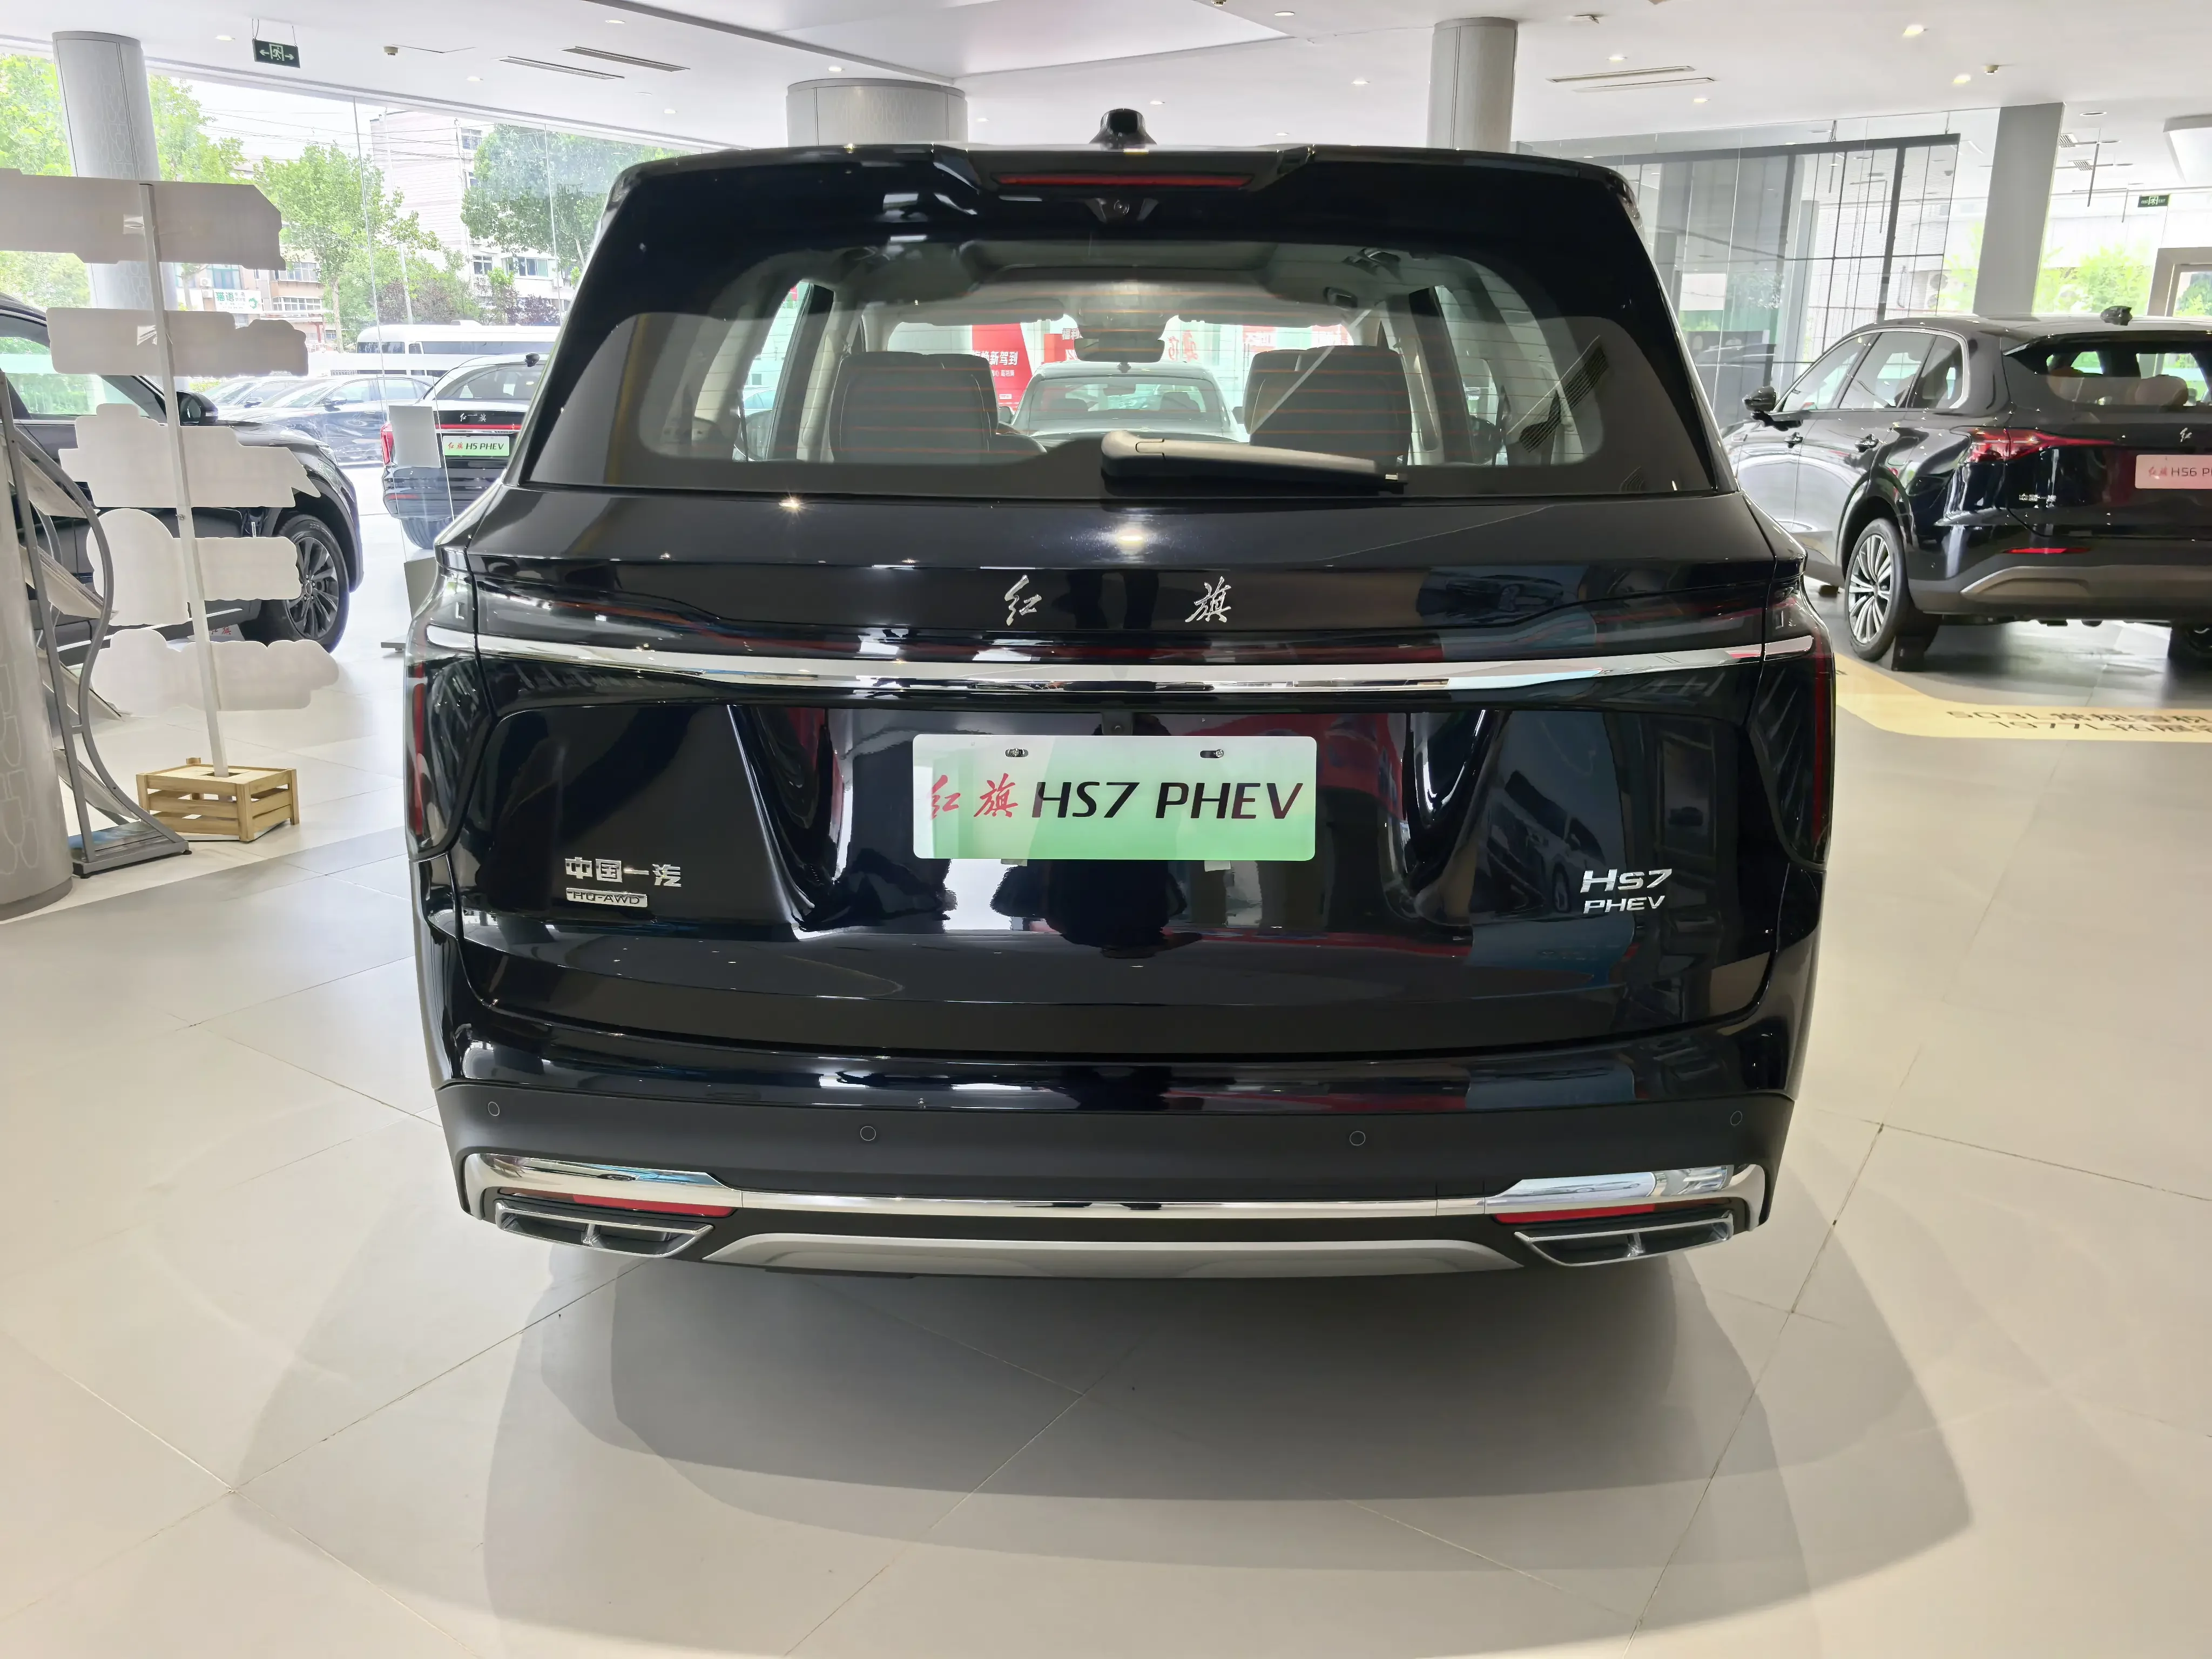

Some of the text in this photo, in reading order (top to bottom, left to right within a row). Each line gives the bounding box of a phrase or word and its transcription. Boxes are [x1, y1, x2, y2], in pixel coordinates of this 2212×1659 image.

[2171, 467, 2197, 476] HS6
[2202, 468, 2212, 476] P
[926, 773, 1304, 821] 红旗 HS7 PHEV
[565, 857, 682, 887] 中国一汽
[1580, 868, 1673, 893] HS7
[572, 891, 640, 905] HQ-AWD
[1583, 895, 1665, 914] PHEV
